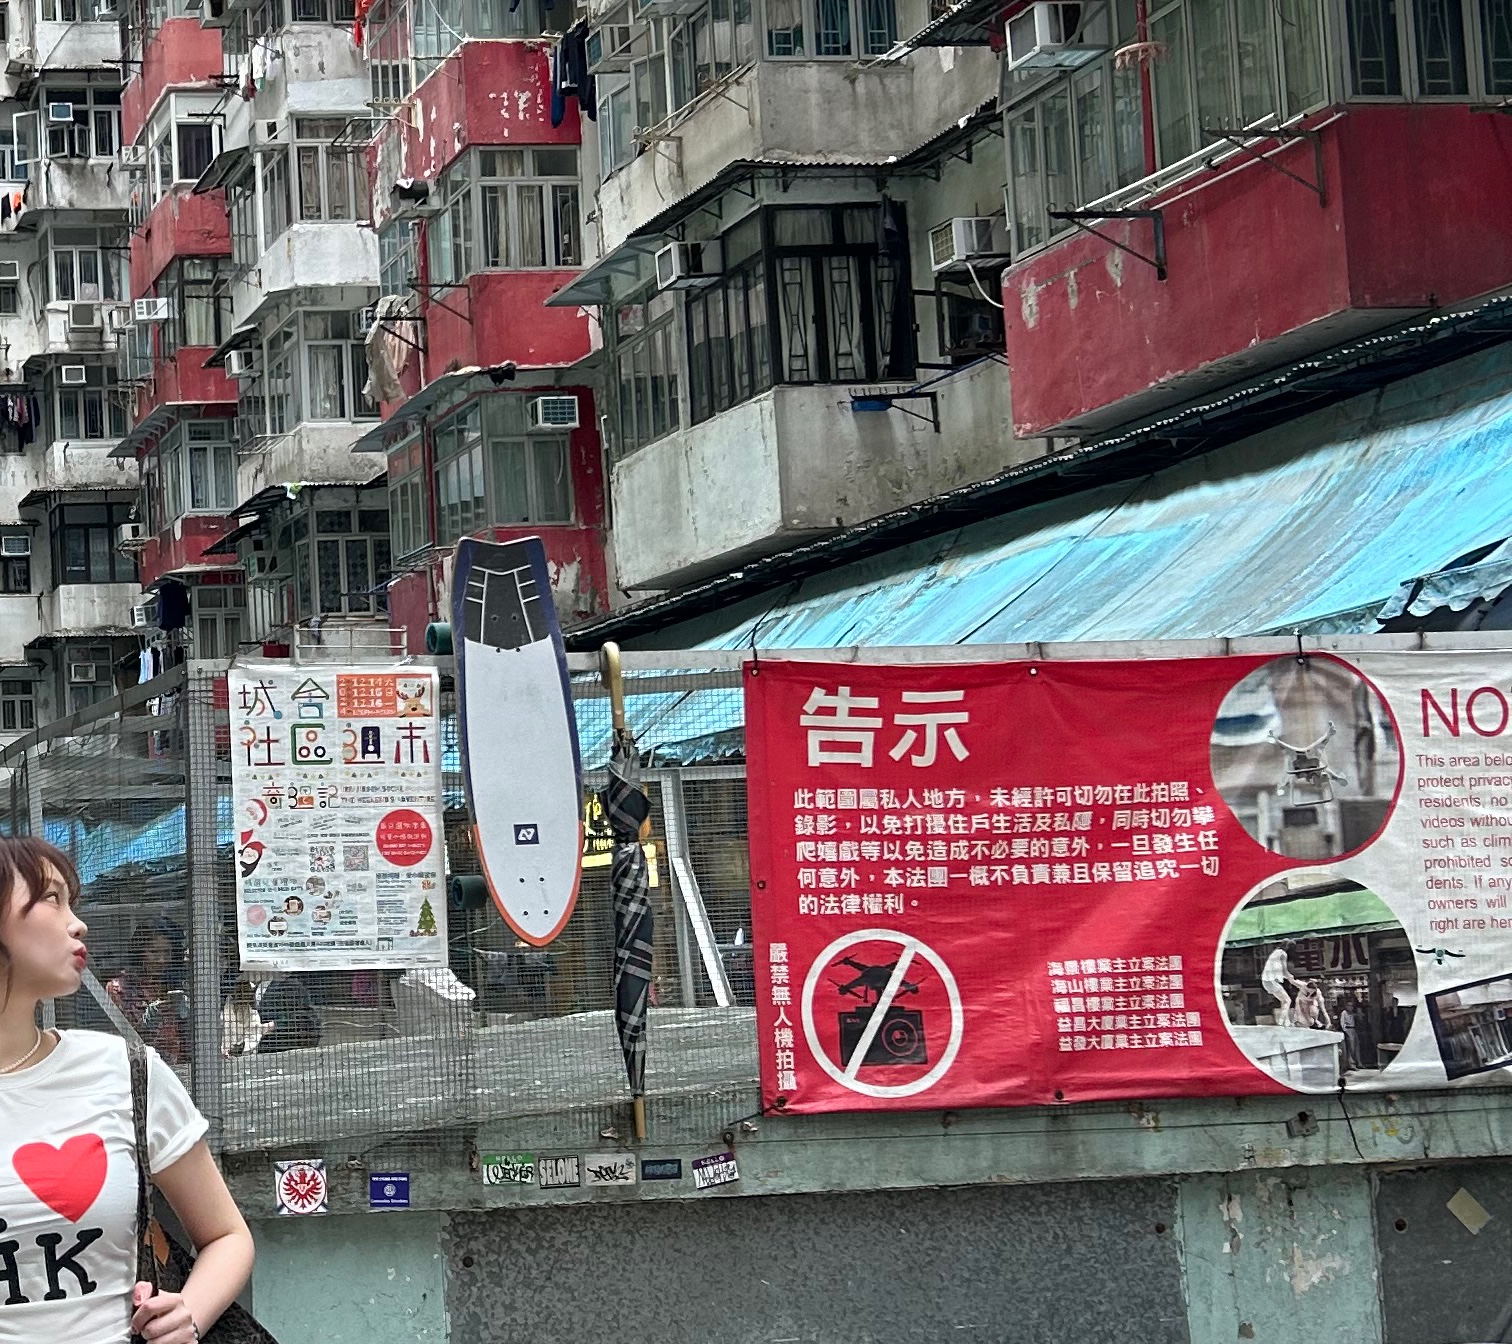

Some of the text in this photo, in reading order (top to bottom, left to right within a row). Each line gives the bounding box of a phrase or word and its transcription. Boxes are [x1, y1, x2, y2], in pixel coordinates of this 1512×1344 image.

[1421, 686, 1512, 738] NO
[800, 686, 970, 768] 告示
[1415, 754, 1445, 768] This
[1449, 755, 1480, 767] area
[1417, 774, 1512, 792] protect privac
[1491, 796, 1508, 807] no
[1420, 816, 1464, 829] videos
[1422, 835, 1454, 849] such
[1461, 837, 1477, 848] as
[1424, 855, 1491, 872] prohibited
[1426, 875, 1468, 890] dents.
[1474, 875, 1483, 889] If
[798, 893, 920, 915] 的法律權利。
[1428, 895, 1507, 910] owners will
[1430, 916, 1460, 934] right
[1463, 918, 1486, 930] are
[768, 942, 798, 1092] 嚴禁無人機拍攝
